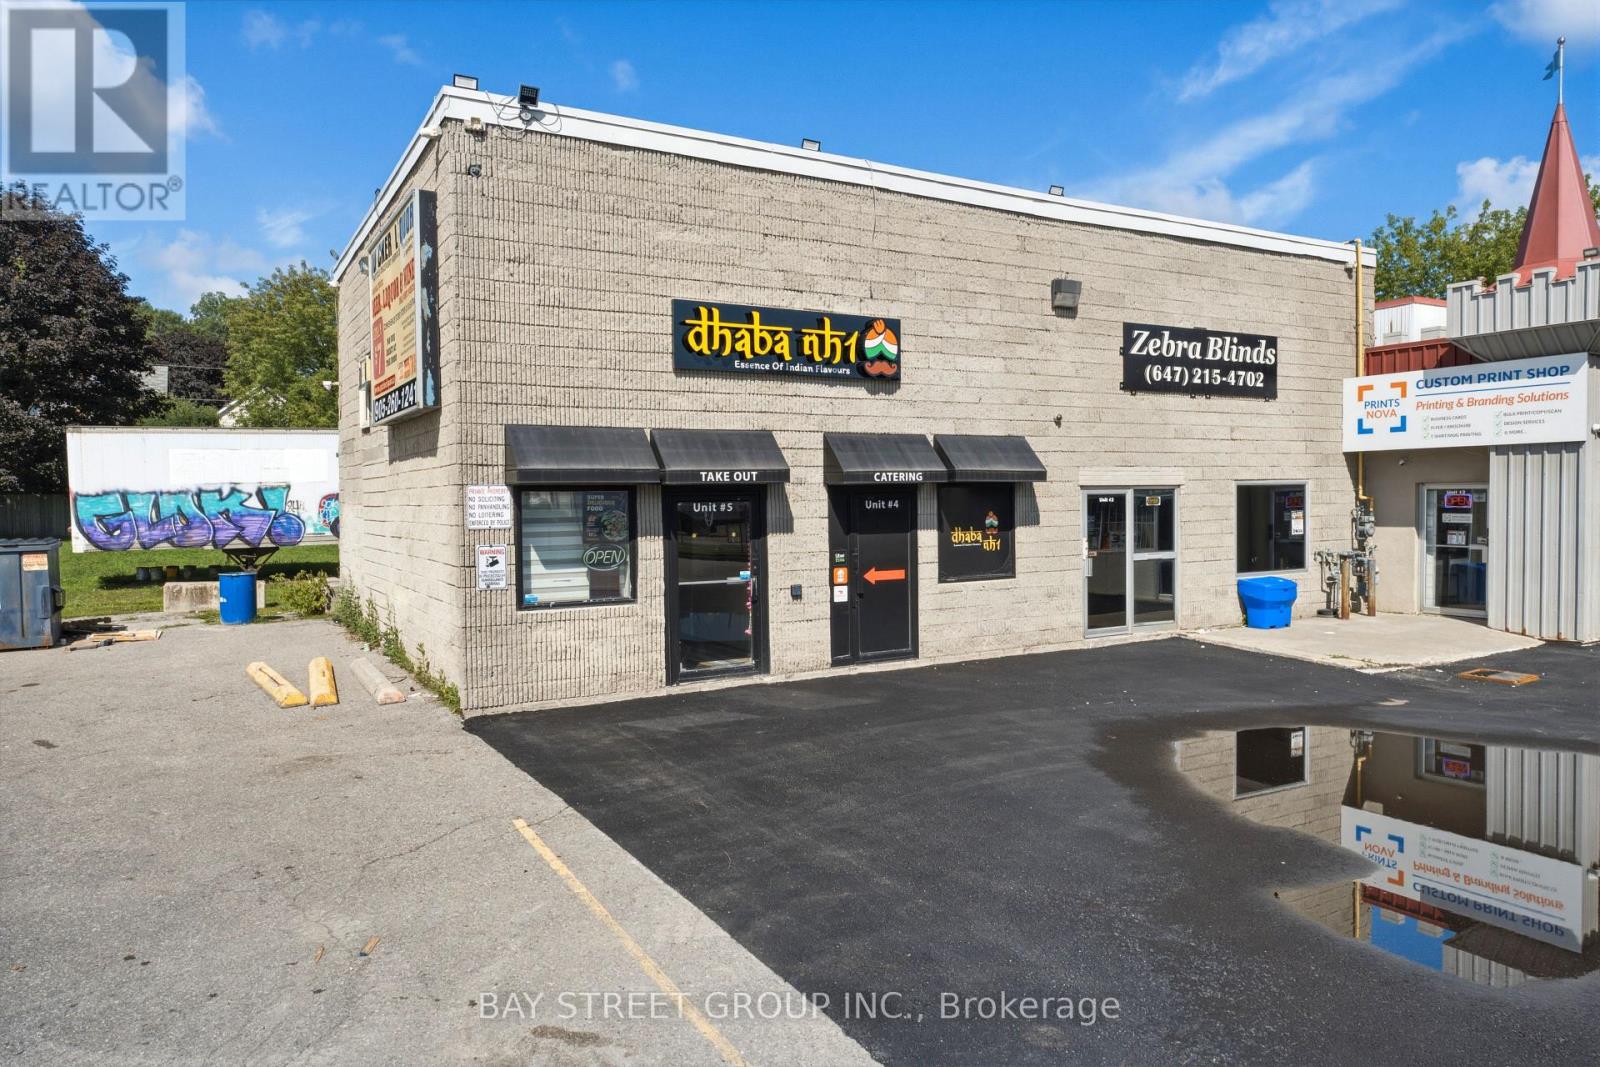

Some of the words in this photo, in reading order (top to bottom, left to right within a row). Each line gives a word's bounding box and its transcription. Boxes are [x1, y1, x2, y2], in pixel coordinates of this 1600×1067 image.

[685, 306, 793, 361] dhaba
[801, 317, 858, 364] nh1
[1129, 330, 1202, 359] Zebra
[1205, 336, 1276, 365] Blinds
[734, 360, 770, 371] Essence
[772, 361, 784, 371] Of
[785, 363, 814, 373] Indian
[815, 364, 850, 375] Flavours
[1144, 364, 1189, 386] (647)
[1192, 368, 1264, 387] 215-4702
[1416, 373, 1473, 390] CUSTOM
[1477, 369, 1522, 384] PRINT
[1527, 365, 1570, 379] SHOP
[1364, 398, 1400, 409] PRINTS
[1416, 398, 1454, 411] Printing
[1456, 397, 1465, 408] &
[1467, 394, 1514, 408] Branding
[1517, 390, 1569, 404] Solutions
[1366, 409, 1397, 419] NOVA
[700, 471, 730, 482] TAKE
[733, 471, 758, 481] OUT
[873, 472, 923, 482] CATERING
[693, 503, 717, 512] Unit
[720, 502, 733, 512] #5
[865, 500, 886, 509] Unit
[888, 500, 899, 508] #4
[951, 526, 982, 543] dhaba
[585, 550, 621, 564] OPEN
